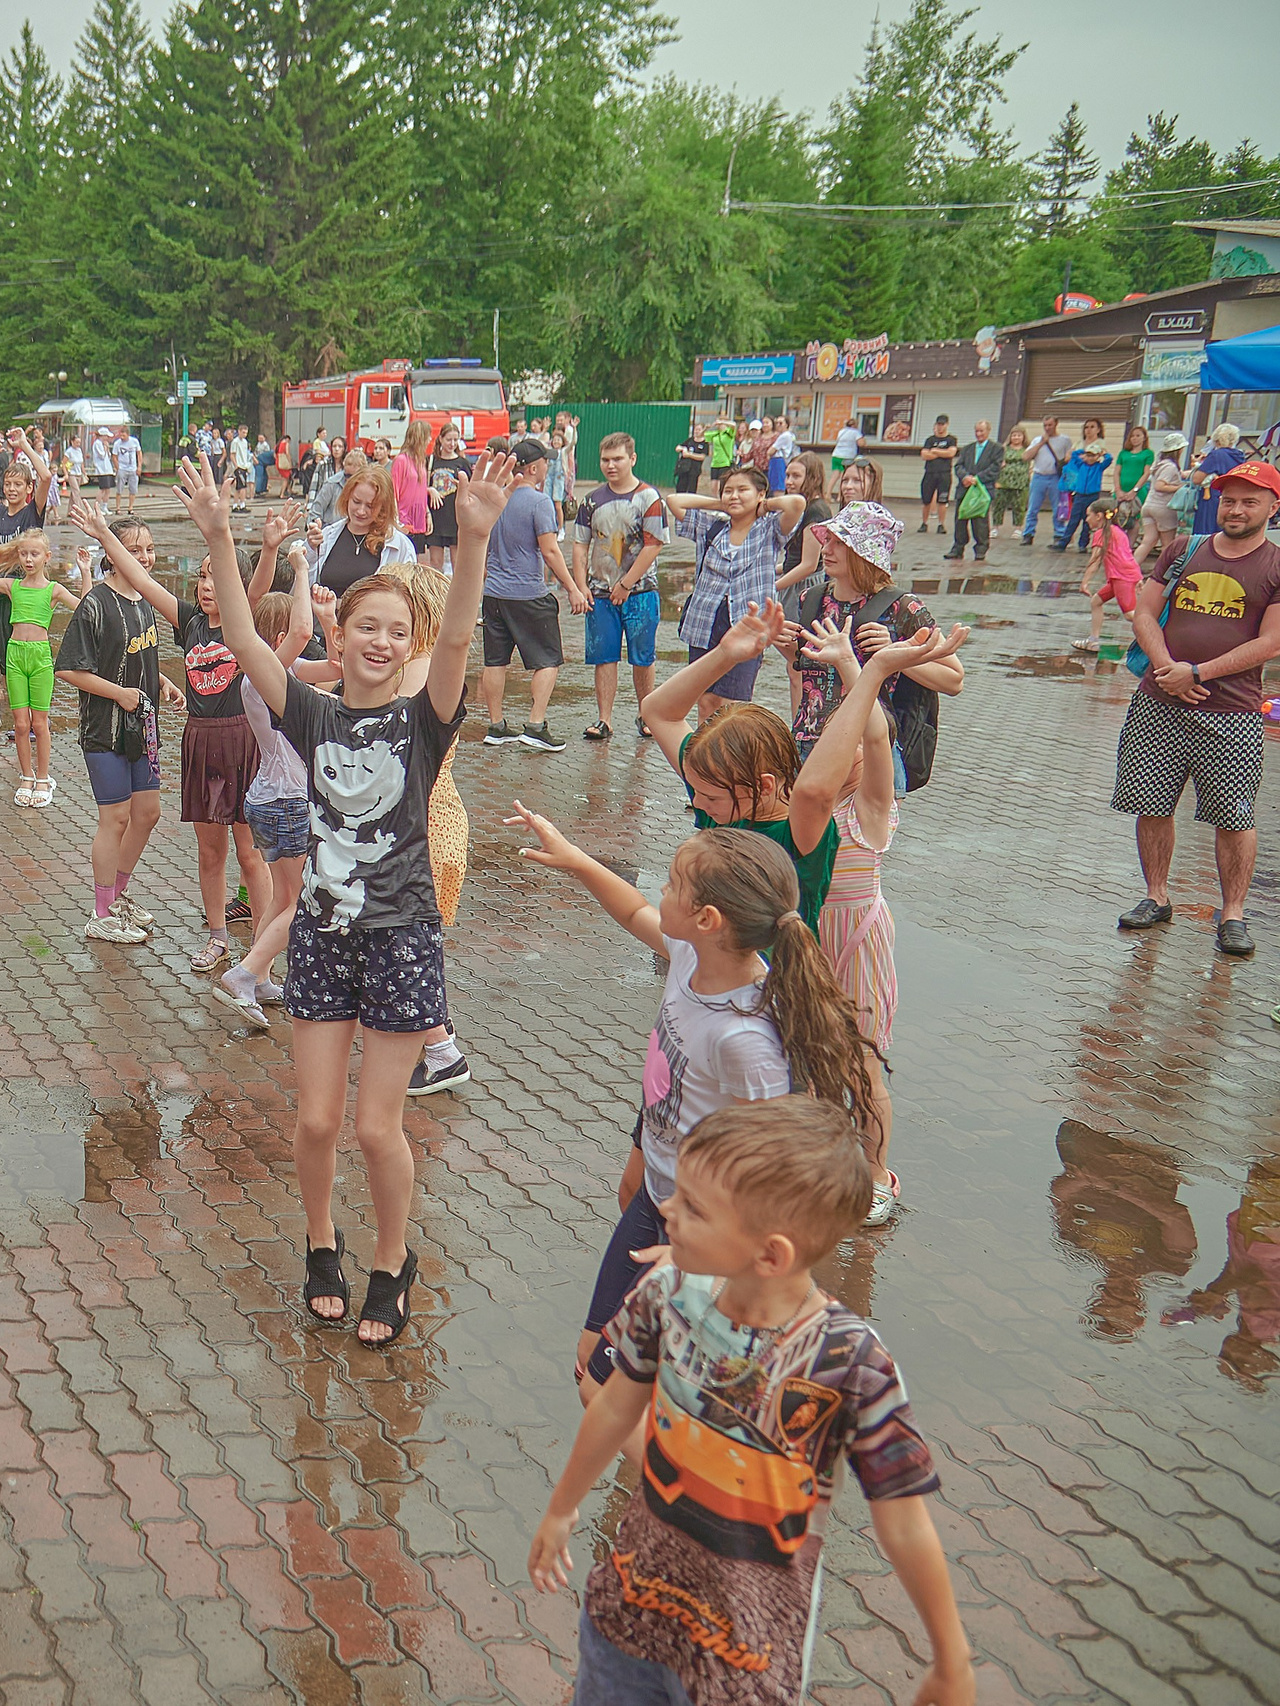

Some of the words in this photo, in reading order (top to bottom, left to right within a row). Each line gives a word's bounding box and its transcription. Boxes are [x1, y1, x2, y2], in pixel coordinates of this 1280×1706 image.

[1157, 316, 1196, 329] ВХОД
[806, 342, 891, 380] ПОНЧИКИ
[376, 418, 381, 429] 1
